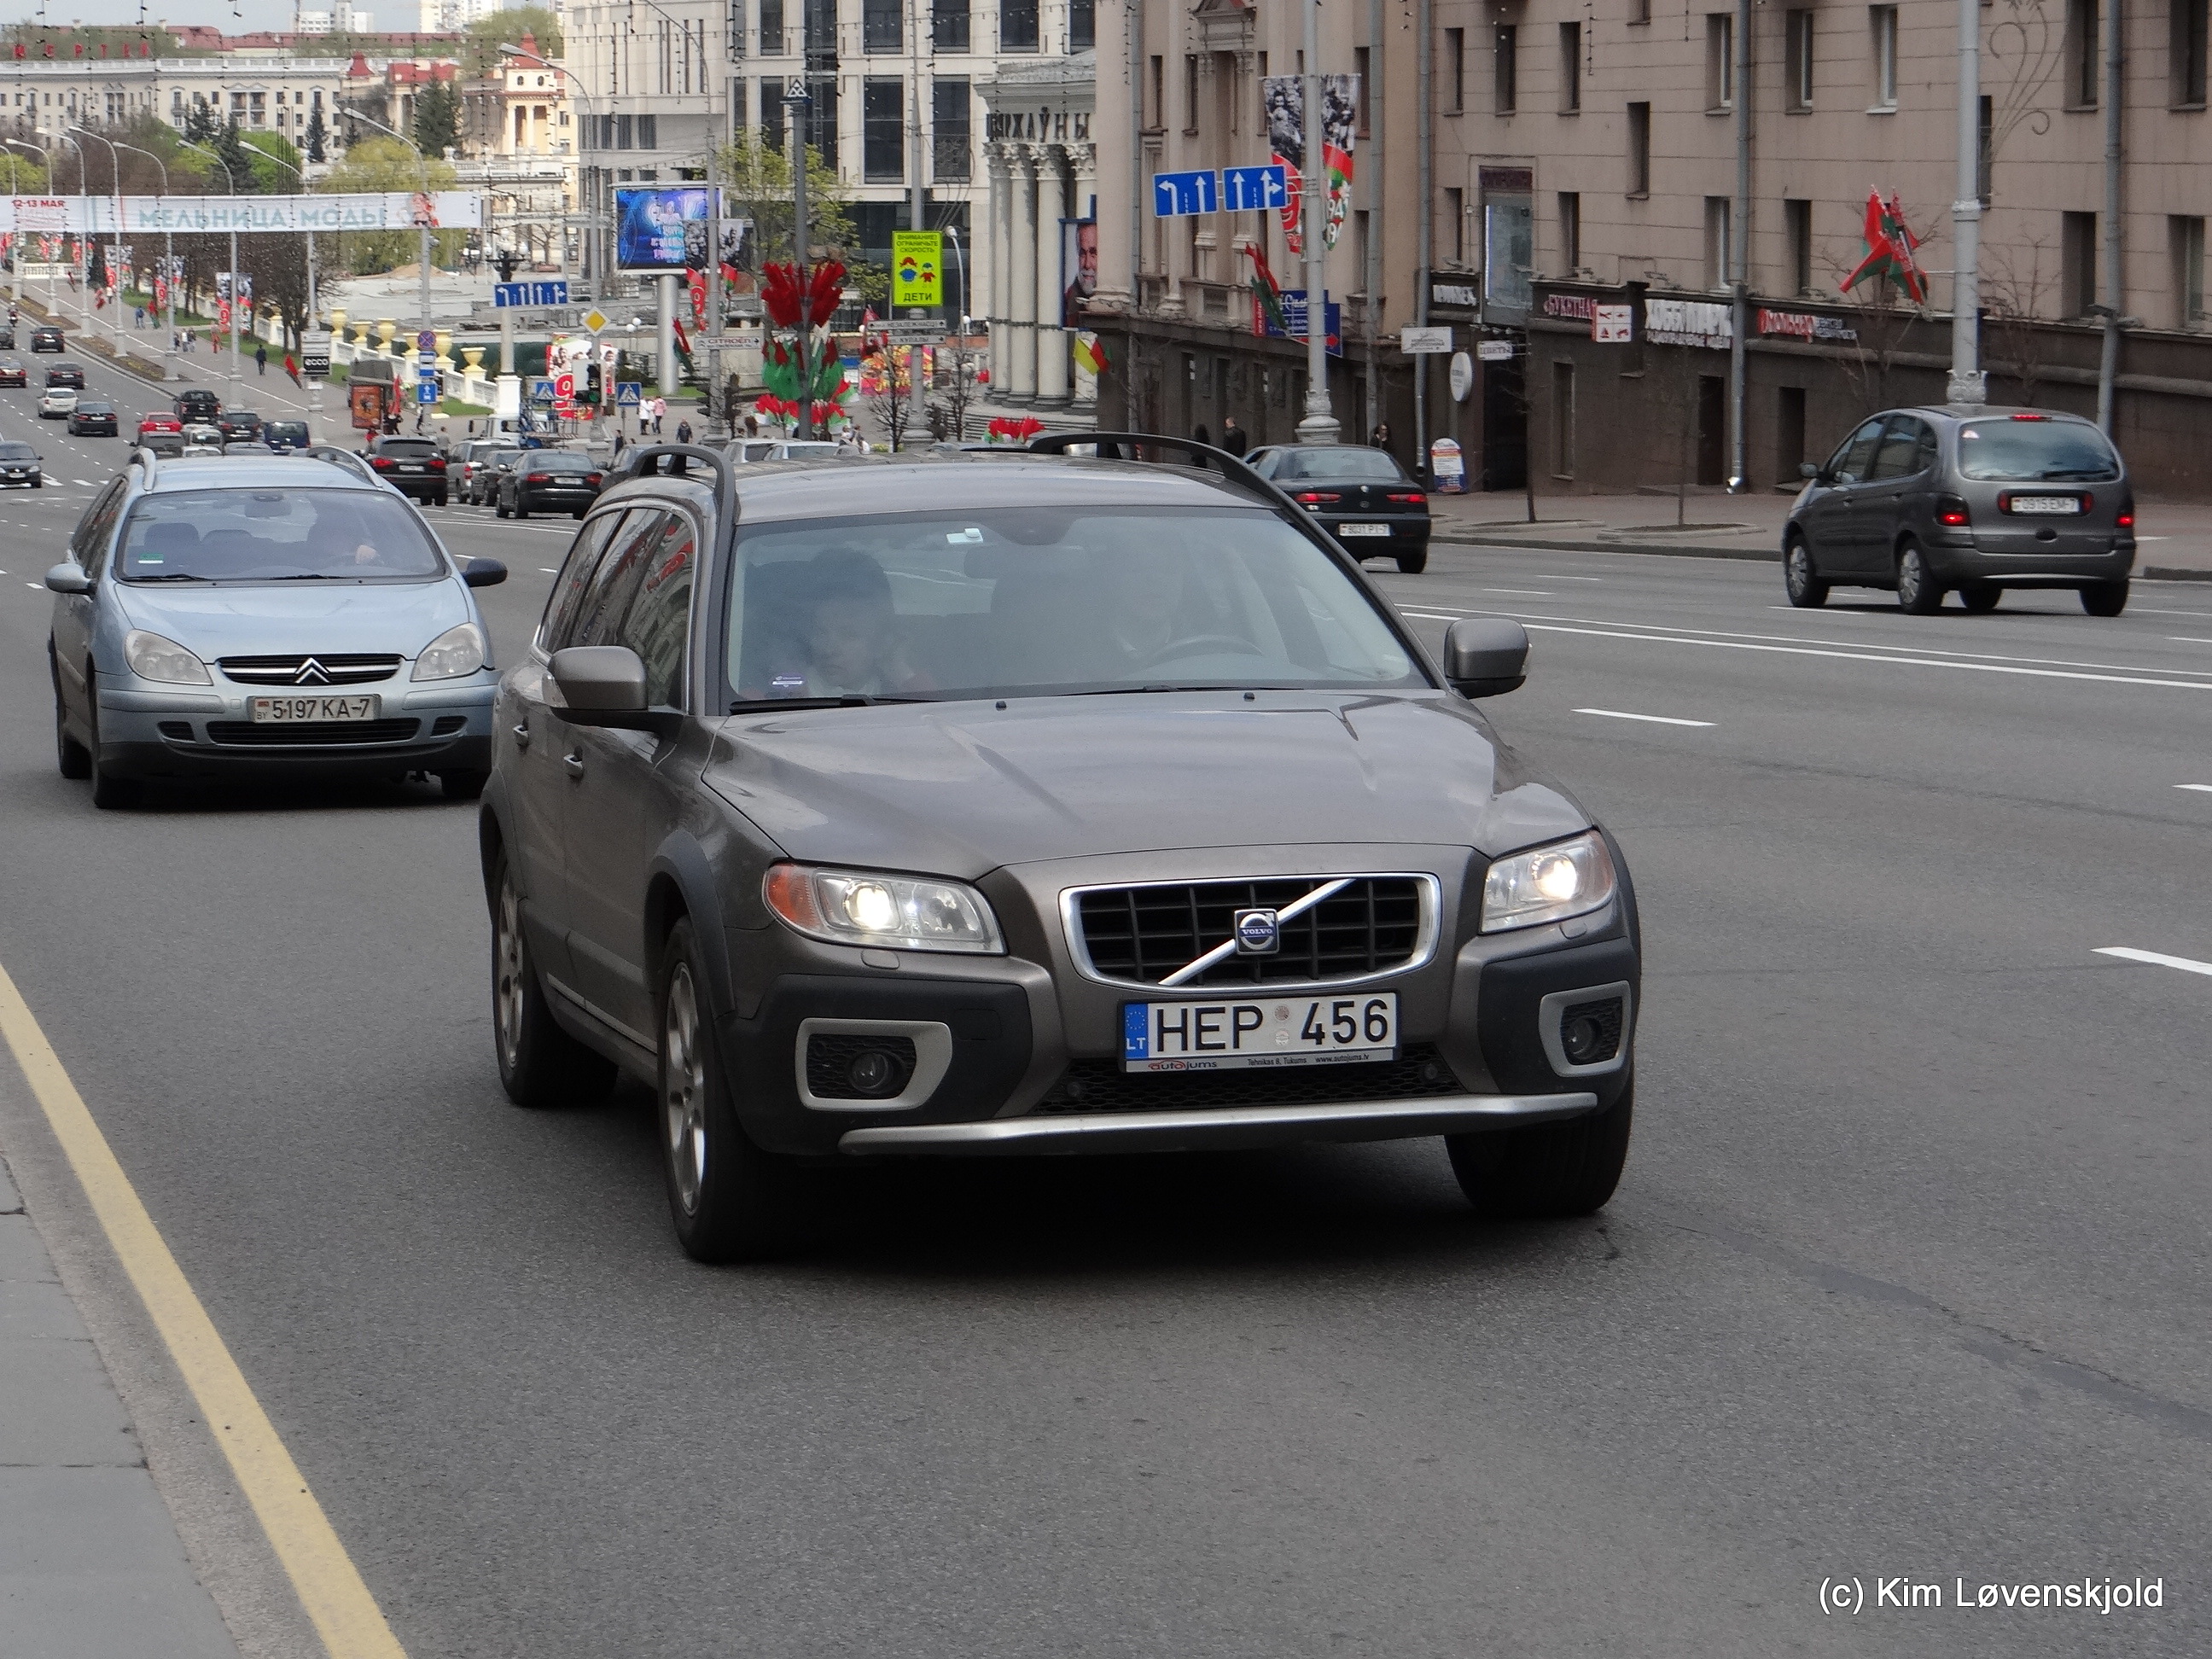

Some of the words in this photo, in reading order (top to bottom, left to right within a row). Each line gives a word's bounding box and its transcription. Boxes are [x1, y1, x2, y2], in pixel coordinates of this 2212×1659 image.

[12, 199, 38, 207] 12-13
[138, 207, 288, 229] МЕЛЬНИЦА
[300, 207, 386, 227] МОДЫ
[903, 292, 933, 302] ДЕТИ
[272, 700, 317, 719] 5197
[322, 698, 370, 719] KA-7
[1156, 1005, 1264, 1052] HEP
[1301, 998, 1388, 1045] 456
[1126, 1037, 1146, 1051] LT
[1315, 1053, 1370, 1063] www.autojums.lv
[1149, 1060, 1218, 1071] autojums
